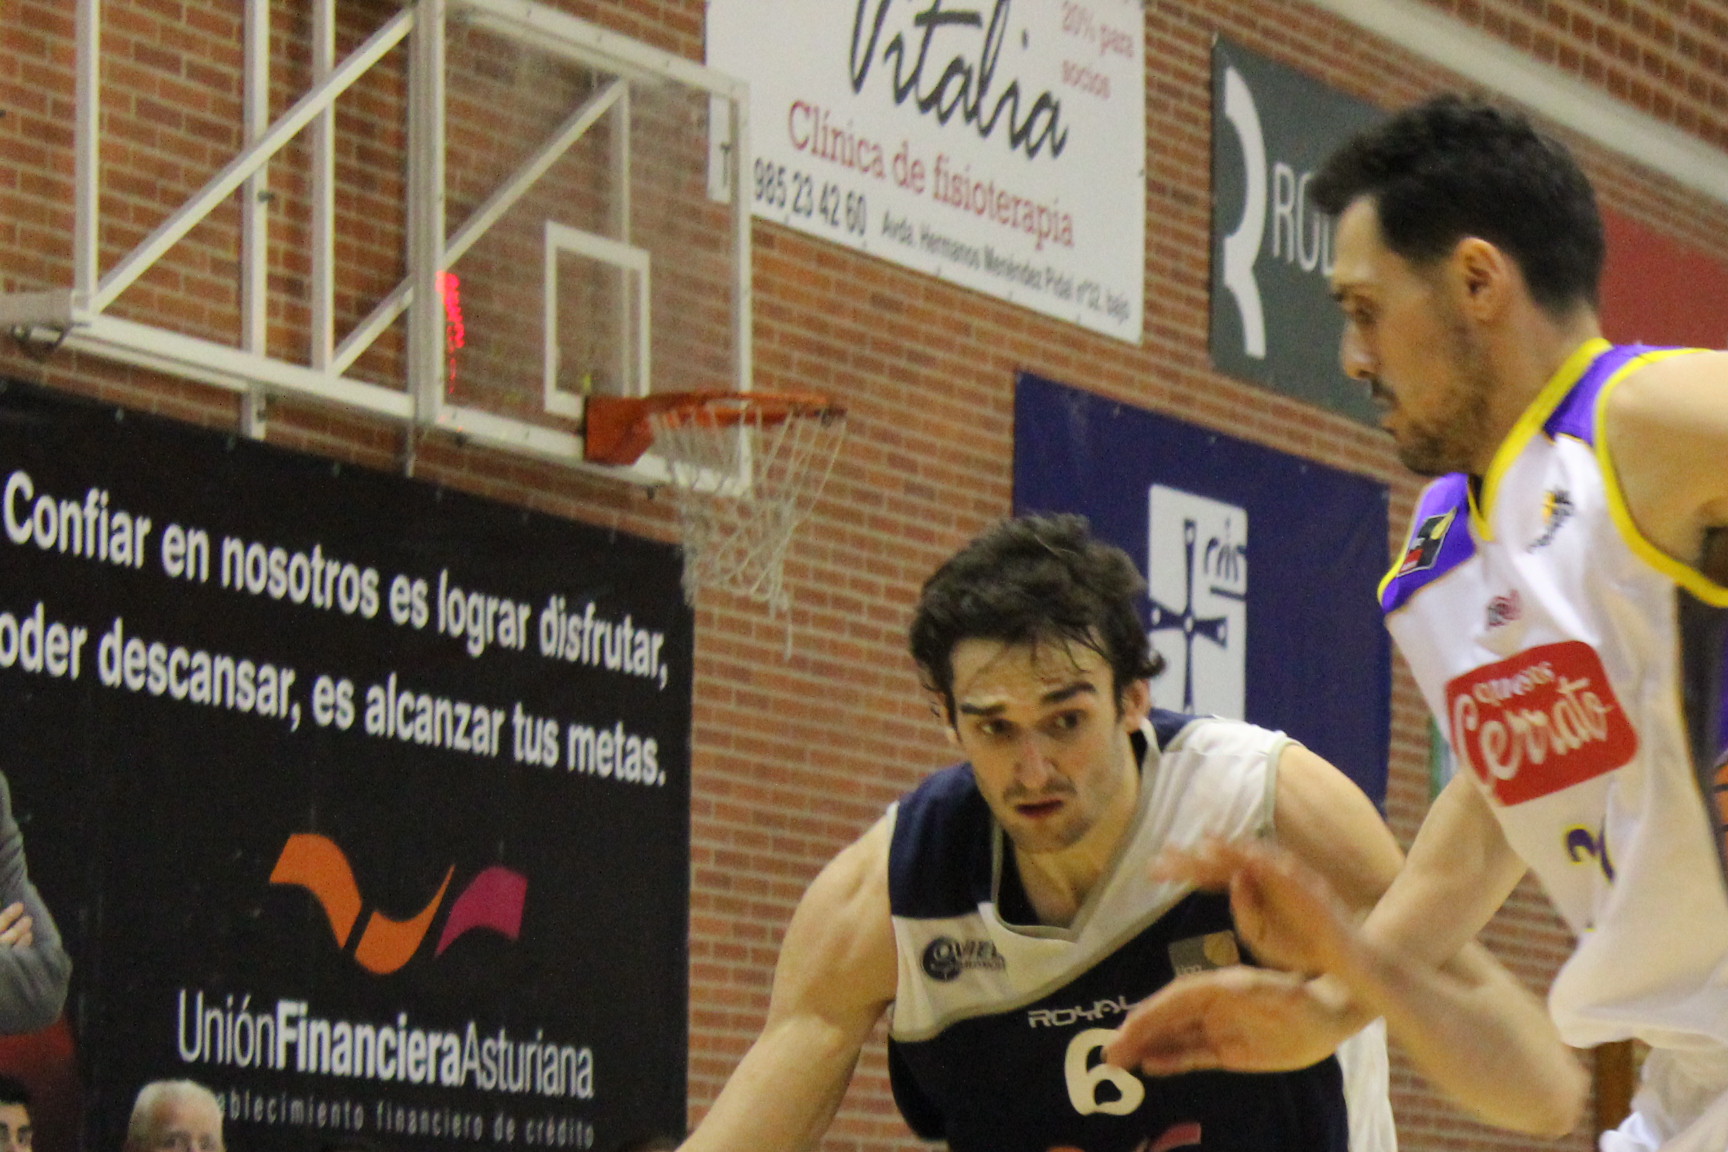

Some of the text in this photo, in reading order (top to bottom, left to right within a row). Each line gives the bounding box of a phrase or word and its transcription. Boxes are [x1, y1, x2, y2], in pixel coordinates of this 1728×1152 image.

[754, 157, 787, 209] 985
[792, 171, 814, 218] 23
[819, 182, 841, 227] 42
[846, 190, 867, 236] 60
[788, 100, 1075, 251] Clínica de fisioterapia
[3, 471, 669, 691] Confiar en nosotros es lograr disfrutar,
[0, 601, 667, 786] oder descansar, es alcanzar tus metas.
[1027, 995, 1142, 1029] ROYAL
[1064, 1027, 1145, 1117] 6
[376, 1102, 484, 1140] financiero
[494, 1112, 516, 1143] de
[526, 1117, 595, 1151] crédito
